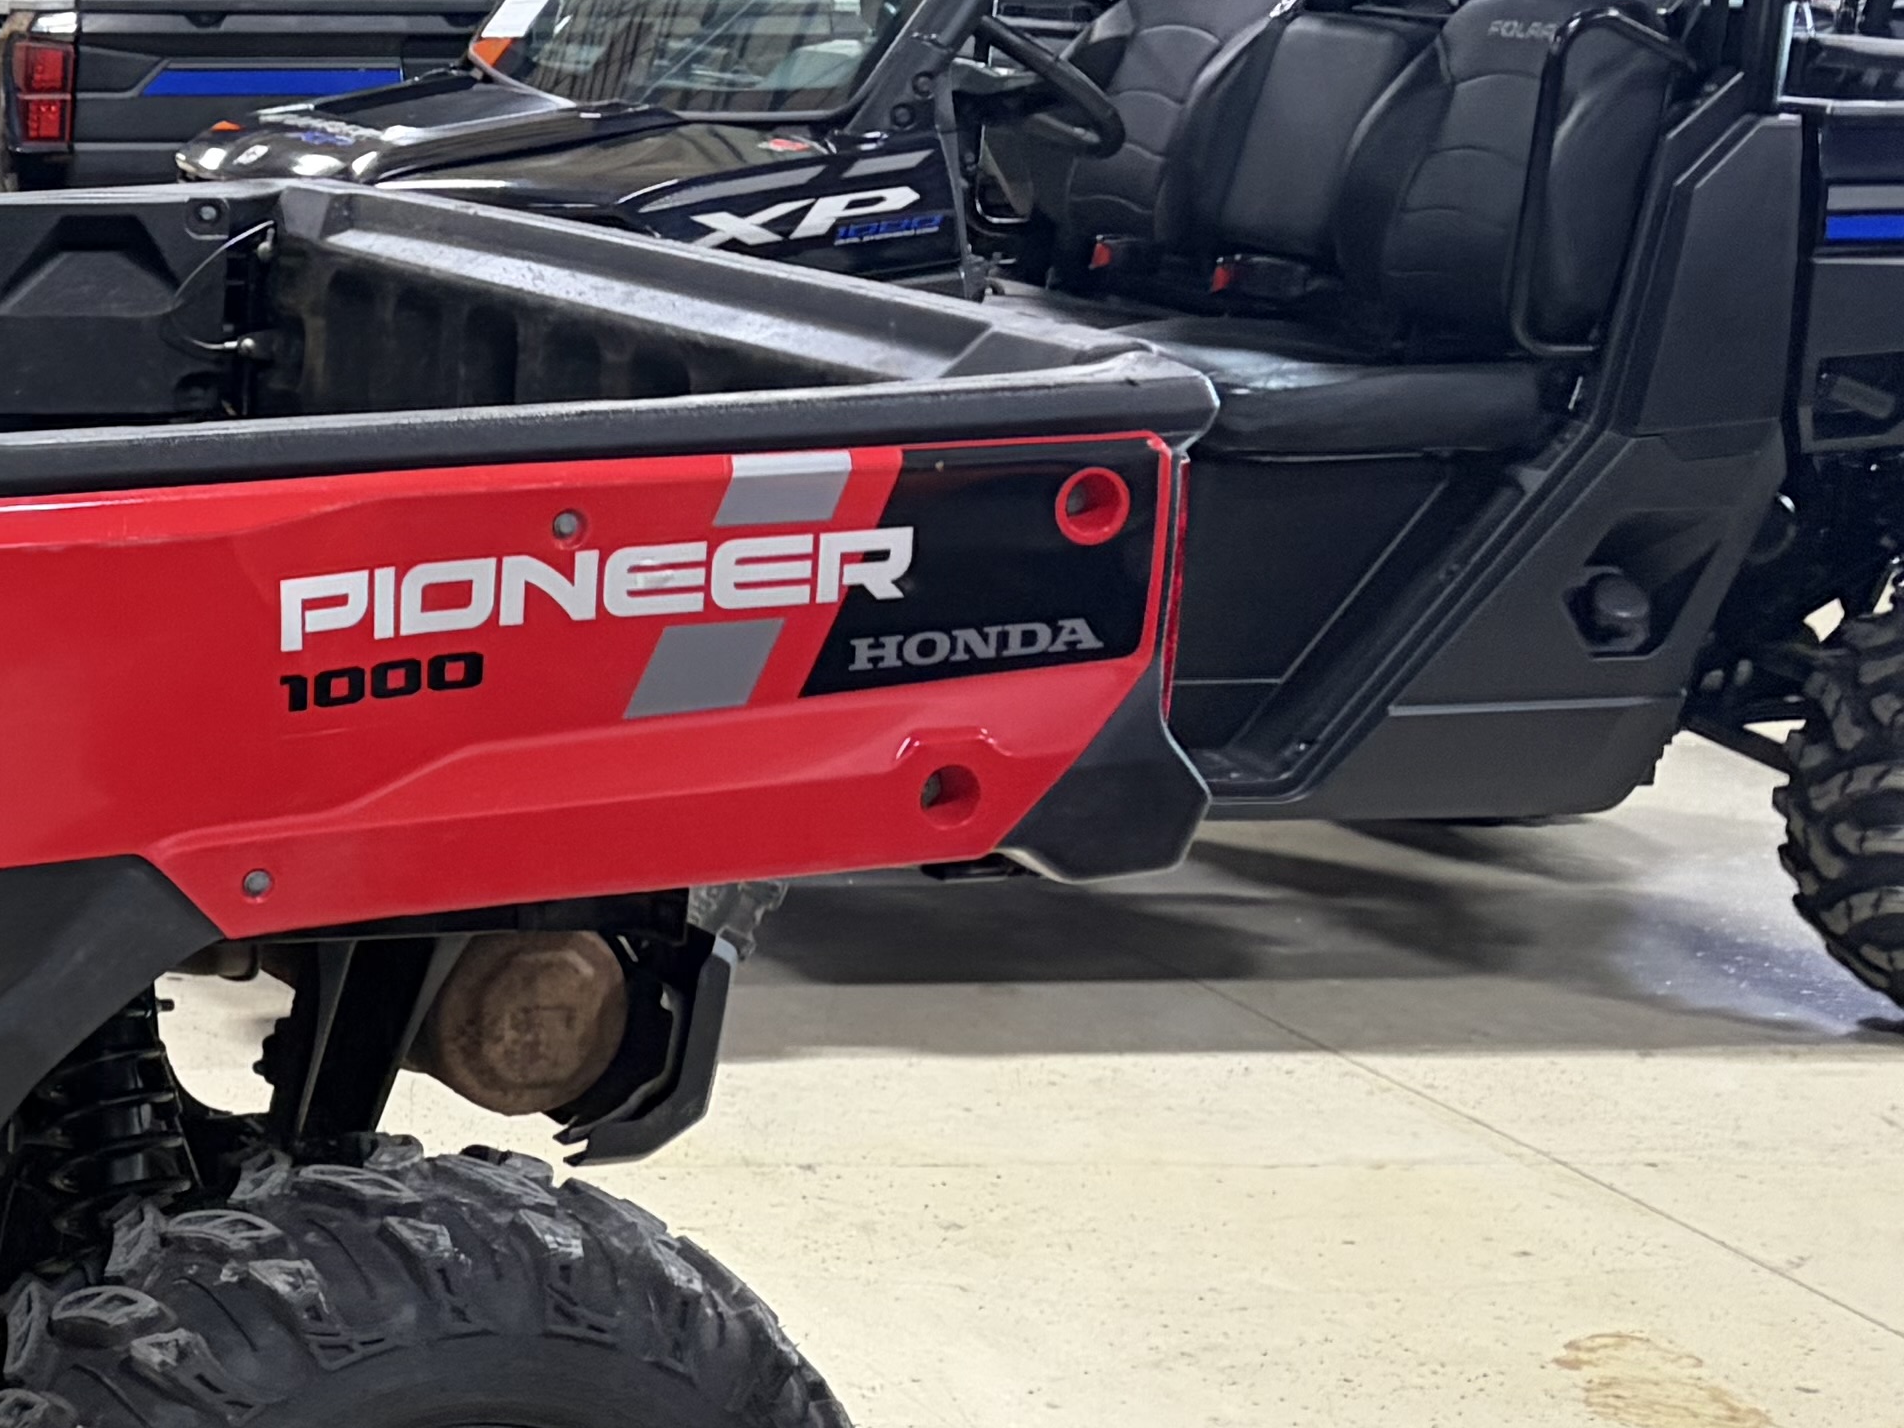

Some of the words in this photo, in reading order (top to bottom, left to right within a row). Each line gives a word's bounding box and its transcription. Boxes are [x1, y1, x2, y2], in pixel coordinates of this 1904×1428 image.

[1487, 19, 1558, 42] POLAR
[689, 185, 921, 248] XP
[279, 526, 915, 653] PIONEER
[847, 618, 1103, 672] HONDA
[279, 651, 484, 713] 1000
